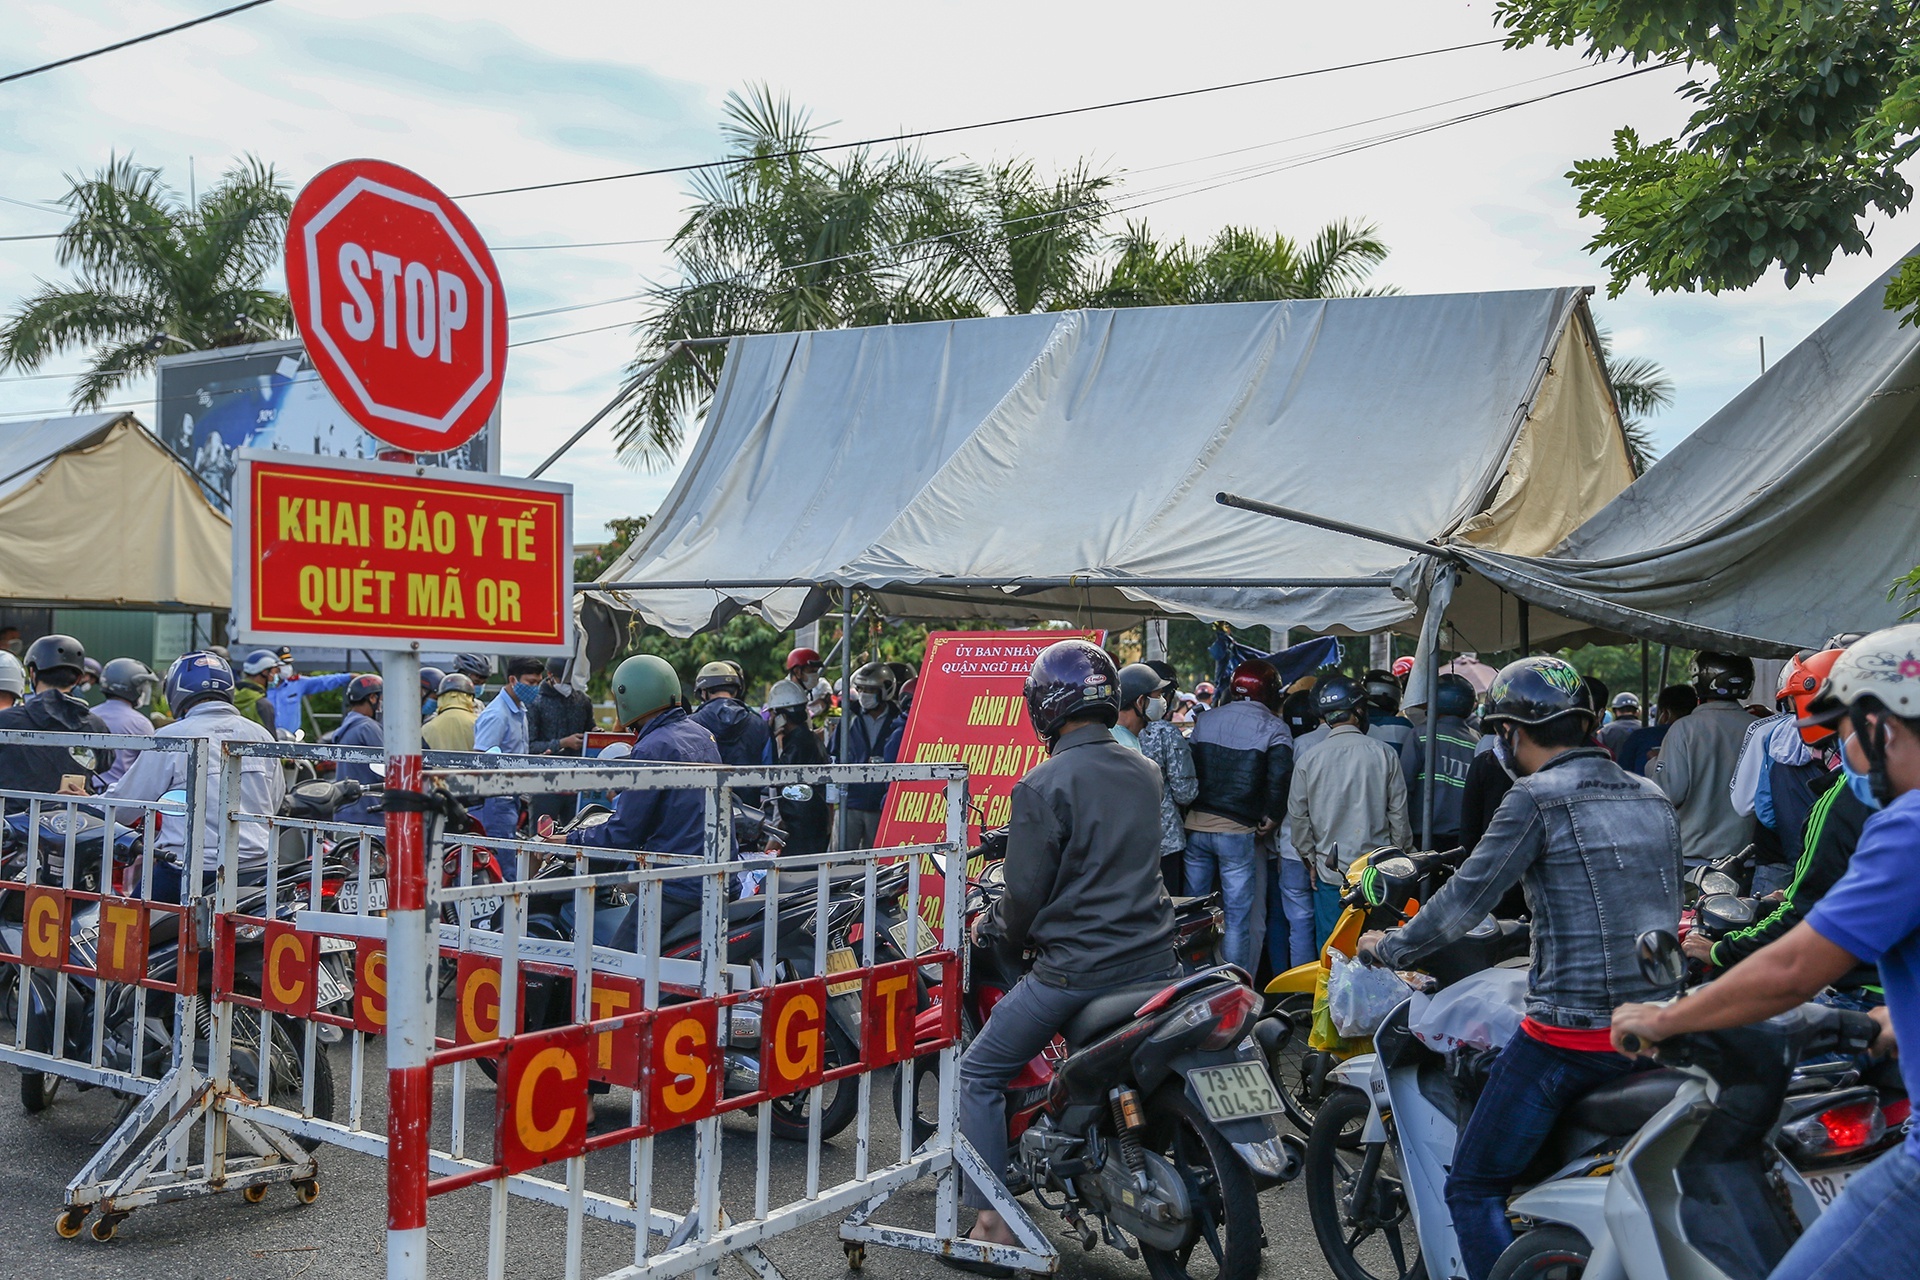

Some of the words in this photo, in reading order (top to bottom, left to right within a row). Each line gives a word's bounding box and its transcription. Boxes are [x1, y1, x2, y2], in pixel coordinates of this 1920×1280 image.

[338, 241, 468, 364] STOP
[278, 496, 371, 547] KHAI
[383, 500, 456, 554] BÁO
[467, 514, 489, 557] Y
[497, 506, 539, 562] TẾ
[299, 560, 396, 616] QUÉT
[407, 567, 466, 620] MÃ
[476, 577, 522, 625] QR
[956, 644, 974, 657] ỦY
[974, 646, 1002, 657] BAN
[1003, 644, 1041, 657] NHÂN
[941, 660, 978, 674] QUẬN
[979, 660, 1008, 673] NGŨ
[1006, 696, 1024, 726] VI
[960, 744, 994, 776] KHAI
[991, 738, 1022, 777] BÁO
[1022, 745, 1036, 777] Y
[894, 791, 931, 823] KHAI
[1201, 1066, 1259, 1092] 73-H1
[1207, 1089, 1278, 1117] 104.52
